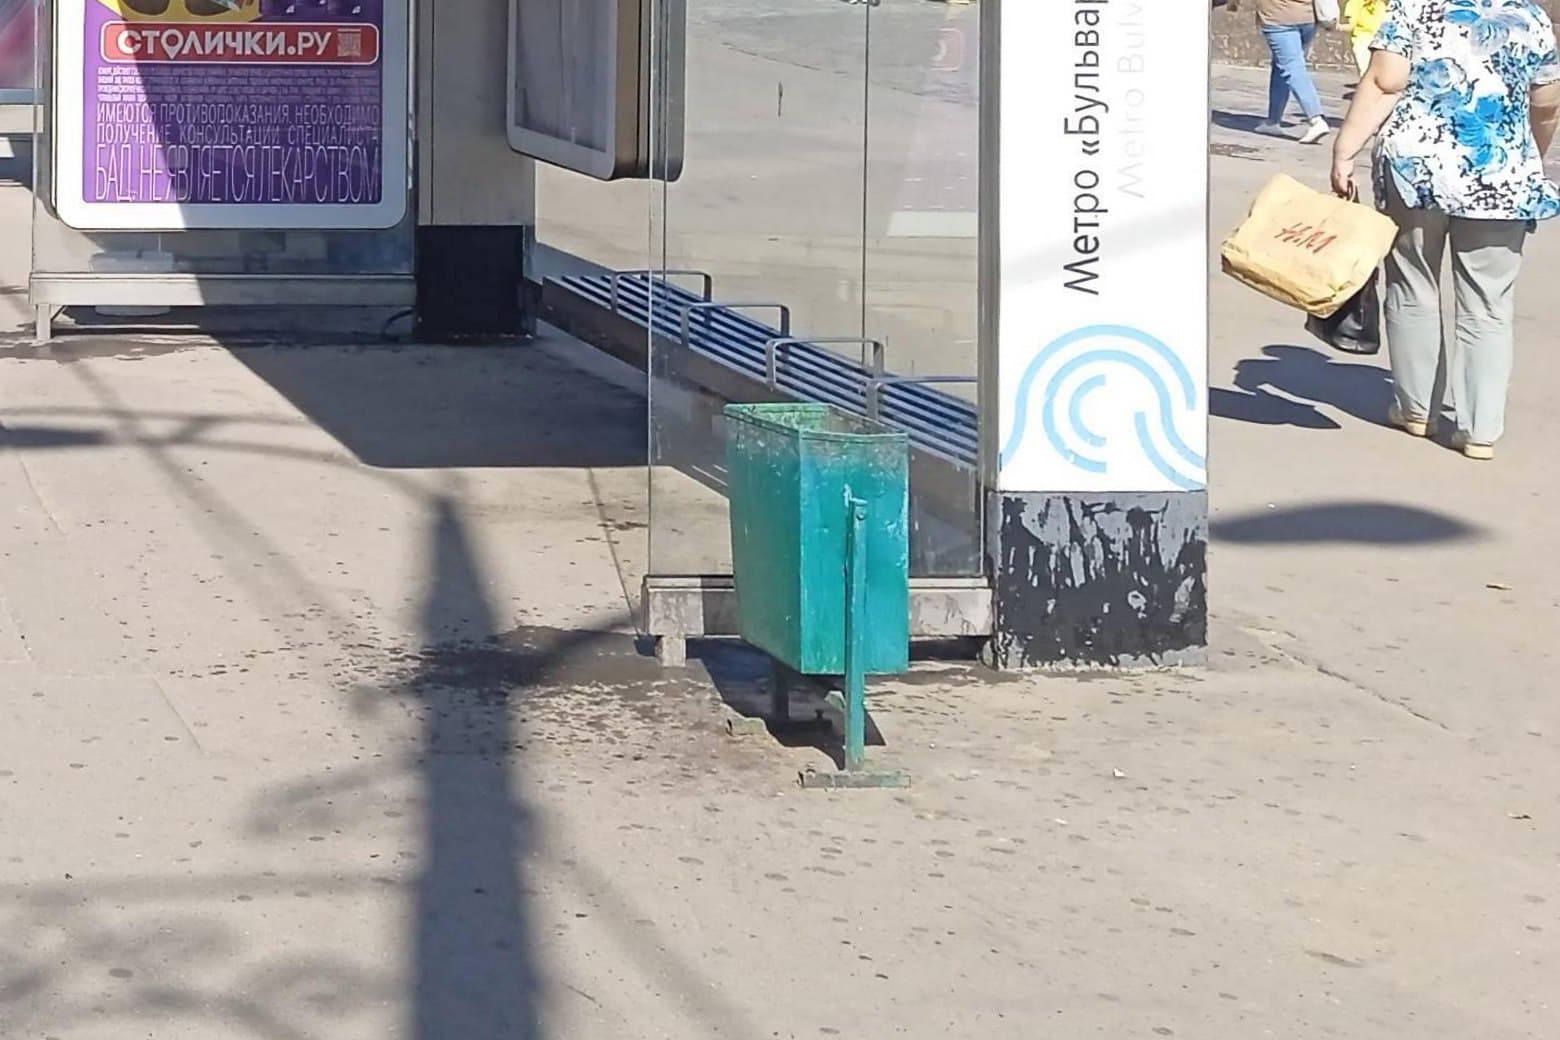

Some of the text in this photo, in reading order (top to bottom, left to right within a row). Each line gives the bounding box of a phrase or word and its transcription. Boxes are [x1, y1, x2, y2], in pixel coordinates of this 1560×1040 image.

[117, 28, 332, 60] СТОЛИЧКИ.РУ
[97, 102, 156, 123] ИМЕЮТСЯ
[295, 104, 379, 125] НЕОБХОДИМО
[97, 123, 172, 144] ПОЛУЧЕНИЕ
[180, 124, 281, 145] КОНСУЛЬТАЦИИ
[1117, 88, 1145, 199] Metro
[139, 144, 164, 202] НЕ
[165, 144, 256, 202] ЯВЛЯЕТСЯ
[257, 145, 379, 202] ЛЕКАРСТВОМ
[1062, 169, 1108, 296] Метро
